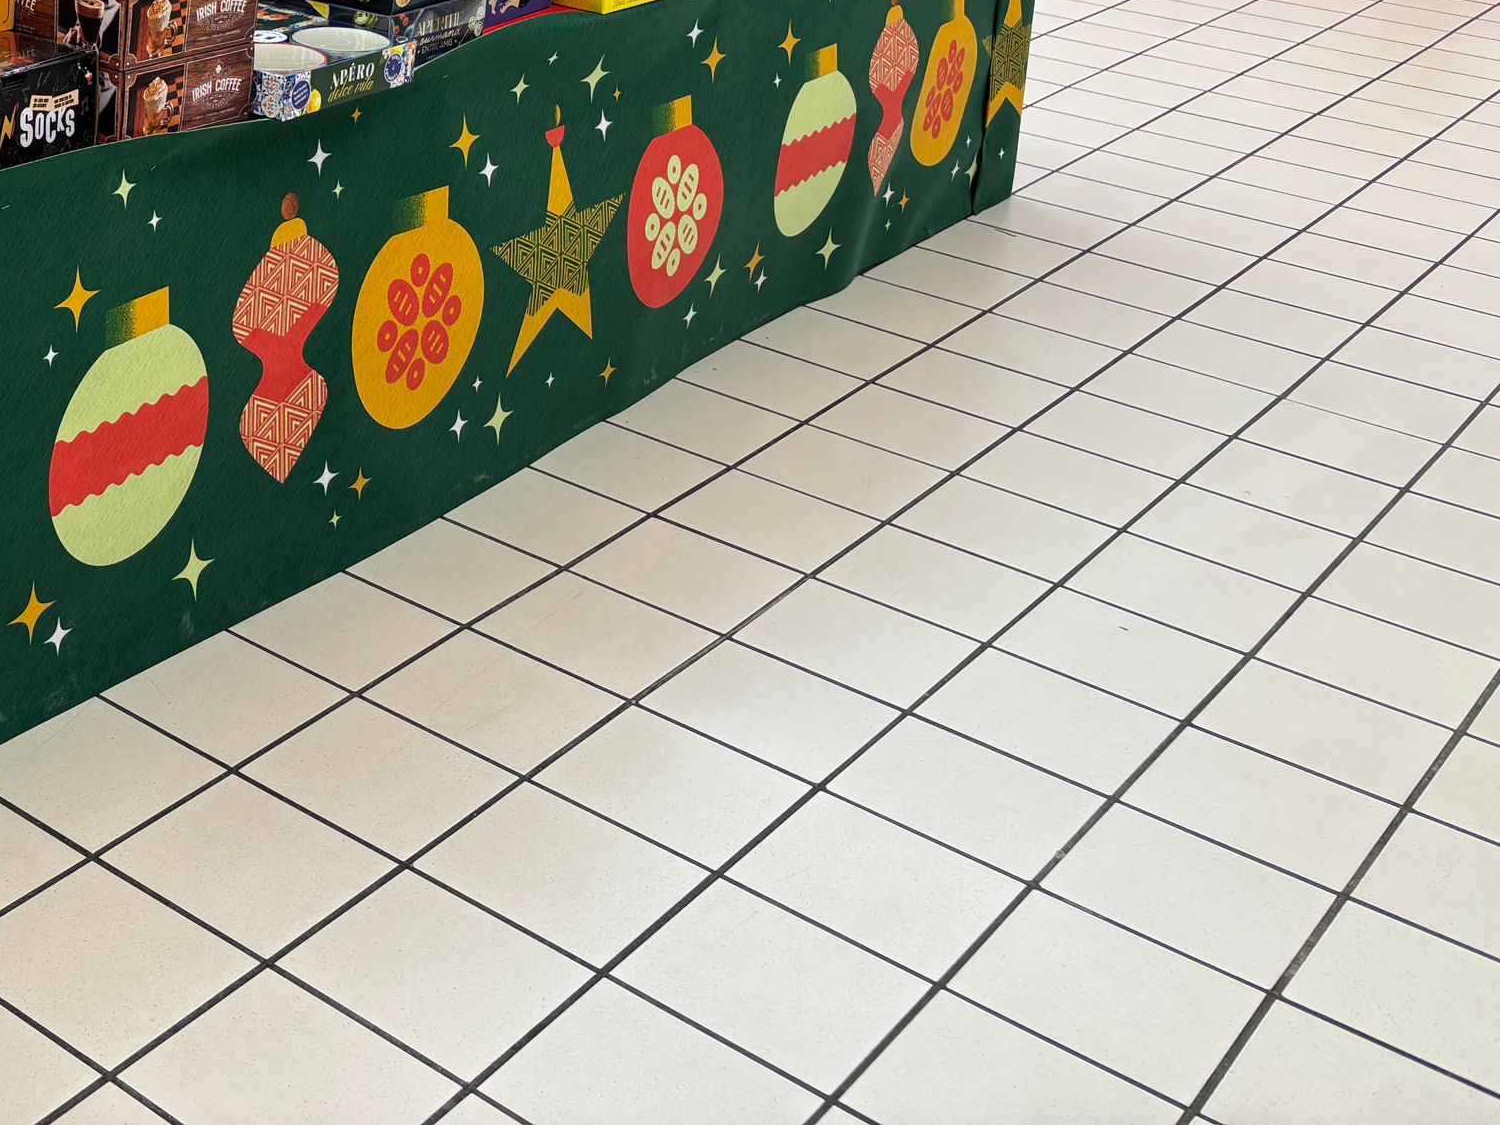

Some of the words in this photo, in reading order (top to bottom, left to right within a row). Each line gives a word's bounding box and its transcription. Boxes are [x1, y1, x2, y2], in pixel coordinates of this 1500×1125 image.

[196, 3, 218, 22] IRISH
[191, 85, 213, 103] IRISH
[214, 77, 243, 94] COFFEE
[19, 106, 76, 149] SOCKS
